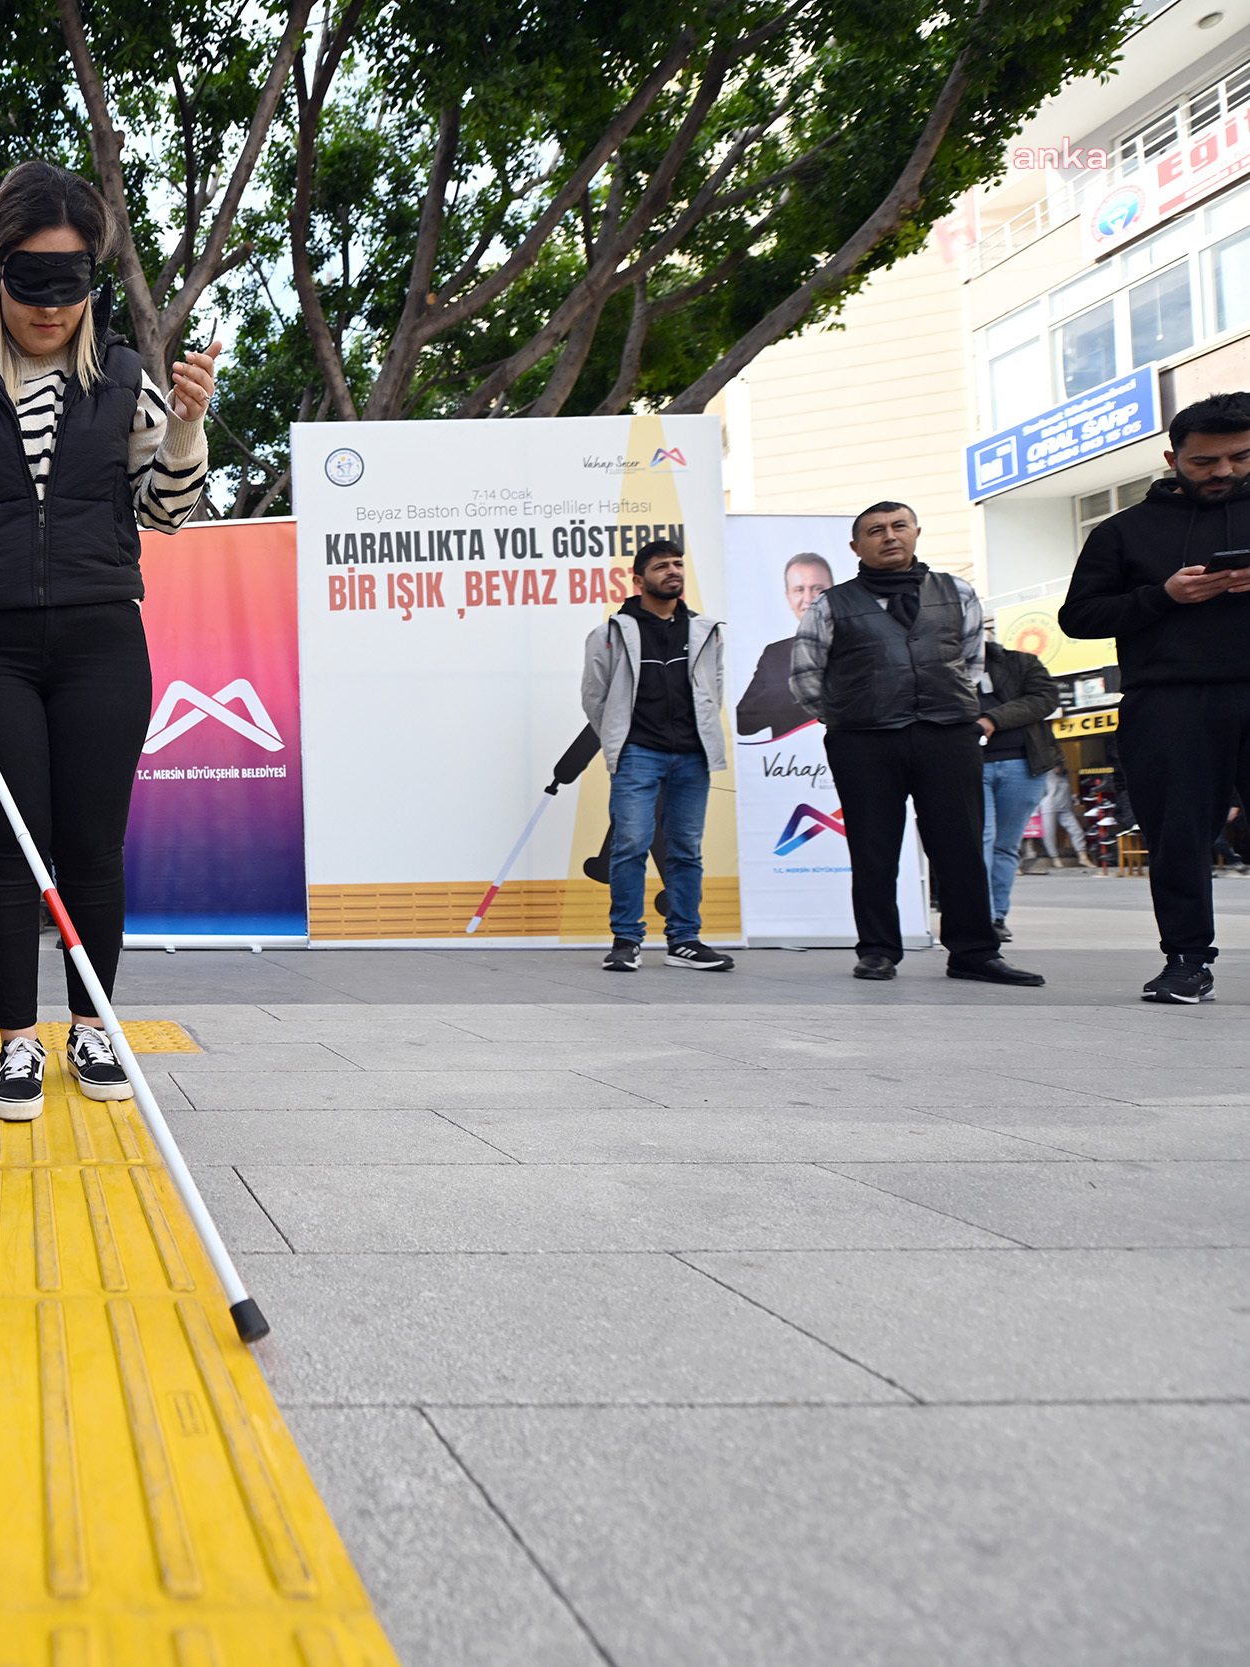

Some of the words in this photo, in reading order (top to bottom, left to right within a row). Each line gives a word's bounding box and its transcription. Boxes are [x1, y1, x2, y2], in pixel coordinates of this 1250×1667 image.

[1027, 429, 1079, 462] ORAL
[1081, 402, 1139, 441] SARP
[583, 455, 614, 474] Vahap
[472, 489, 497, 501] 7-14
[500, 488, 533, 500] Ocak
[356, 506, 402, 524] Beyaz
[407, 504, 460, 519] Baston
[465, 502, 517, 517] Görme
[523, 499, 594, 518] Engelliler
[600, 499, 652, 514] Haftası
[325, 528, 486, 565] KARANLIKTA
[494, 527, 543, 560] YOL
[328, 566, 377, 611] BİR
[387, 571, 446, 621] IŞIK
[1060, 722, 1075, 733] by
[137, 769, 151, 780] T.C.
[153, 766, 185, 780] MERSİN
[187, 765, 240, 781] BÜYÜKŞEHİR
[241, 764, 287, 778] BELEDİYESİ
[763, 752, 828, 789] Vahap
